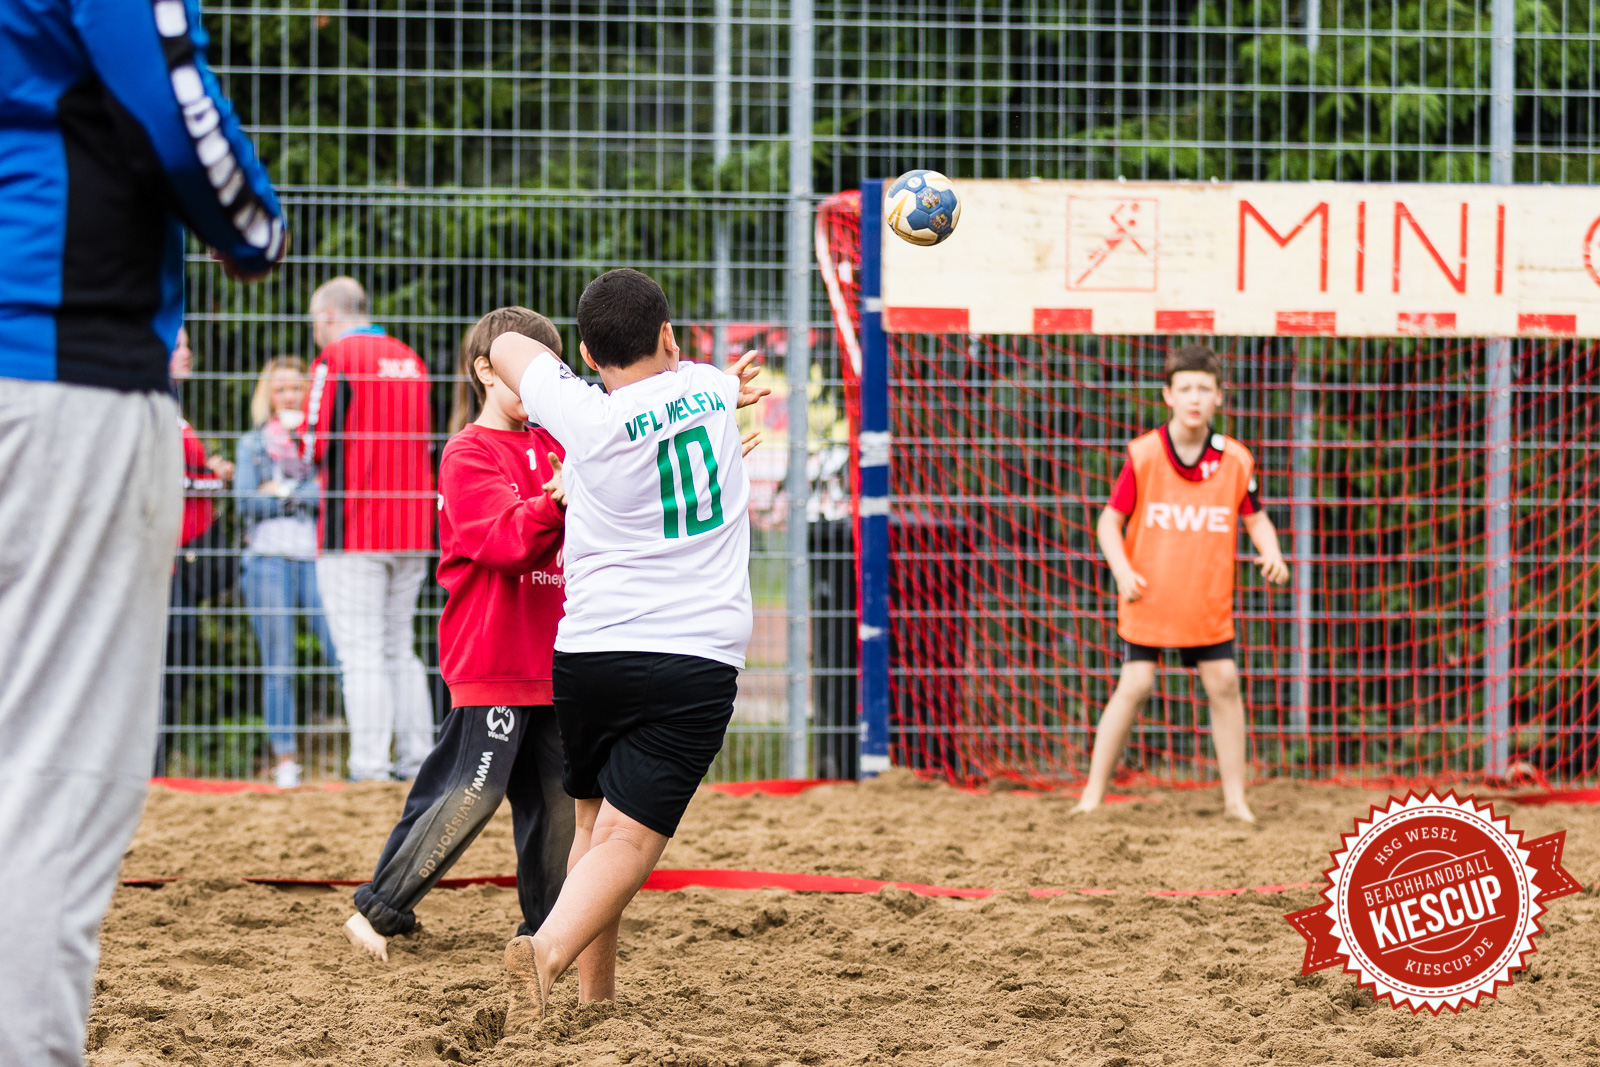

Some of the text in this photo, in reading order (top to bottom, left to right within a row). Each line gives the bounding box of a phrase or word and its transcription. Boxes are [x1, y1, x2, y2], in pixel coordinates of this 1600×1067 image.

[1237, 200, 1505, 295] MINI
[625, 391, 726, 441] VFL WELFIA
[656, 425, 724, 539] 10
[1146, 502, 1231, 533] RWE
[418, 751, 493, 878] www.javisport.de
